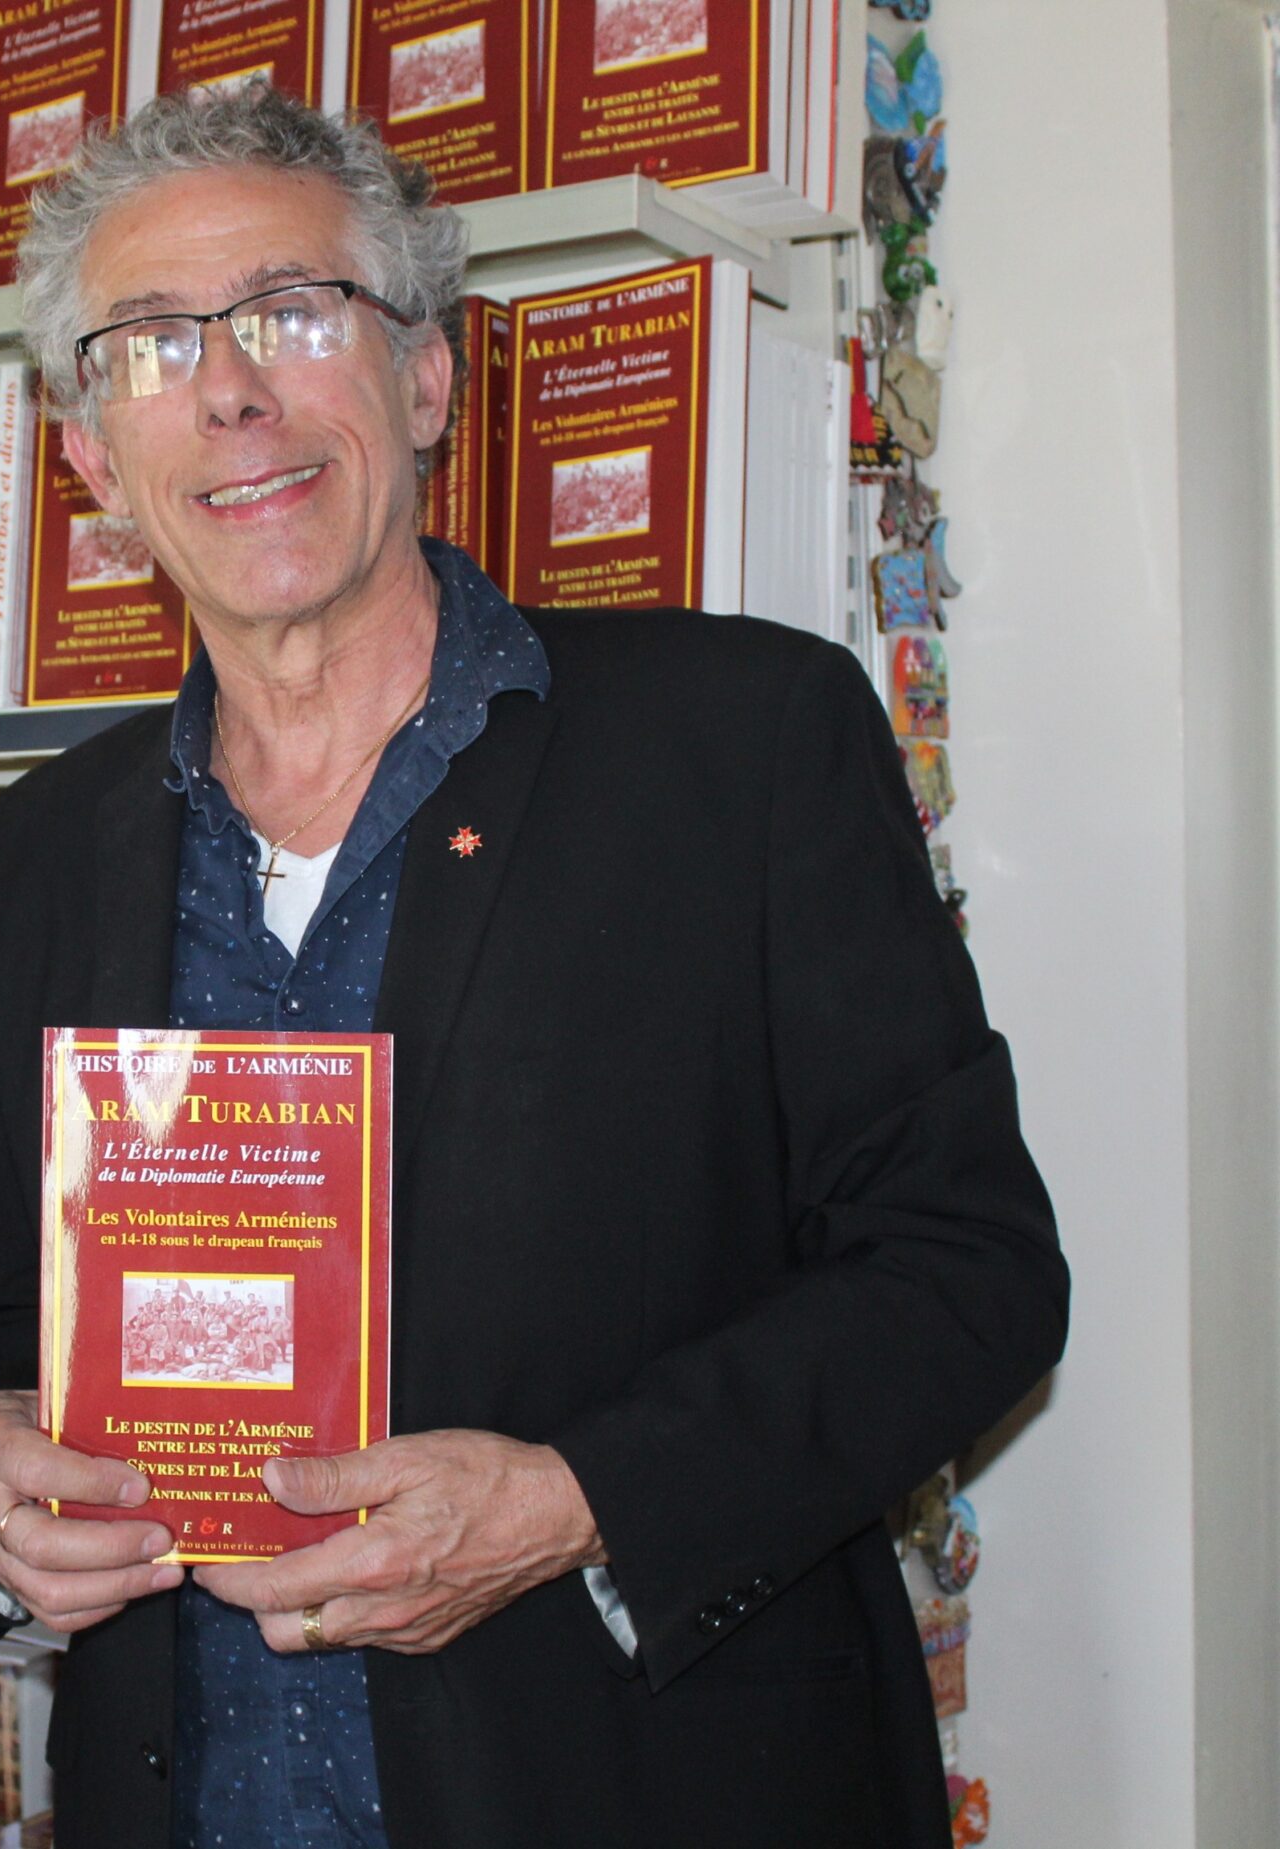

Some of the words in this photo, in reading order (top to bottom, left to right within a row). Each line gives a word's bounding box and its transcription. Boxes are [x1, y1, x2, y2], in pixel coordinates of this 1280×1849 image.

[529, 302, 593, 324] HISTOIRE
[597, 298, 611, 311] DE
[615, 276, 689, 307] L'ARMÉNIE
[524, 334, 584, 360] ARAM
[590, 312, 690, 348] TURABIAN
[0, 380, 18, 465] dictons
[0, 470, 12, 493] et
[77, 1055, 182, 1074] HISTOIRE
[193, 1059, 216, 1074] DE
[227, 1053, 352, 1076] L'ARMÉNIE
[72, 1092, 171, 1122] ARAM
[183, 1095, 356, 1124] TURABIAN
[103, 1141, 228, 1162] L'Éternelle
[240, 1144, 321, 1163] Victime
[98, 1168, 117, 1182] de
[121, 1168, 136, 1182] la
[140, 1168, 225, 1187] Diplomatie
[229, 1169, 325, 1188] Européenne
[87, 1209, 119, 1225] Les
[125, 1209, 229, 1228] Volontaires
[236, 1211, 337, 1229] Arméniens
[101, 1236, 116, 1246] en
[121, 1232, 157, 1246] 14-18
[160, 1236, 189, 1247] sous
[193, 1233, 205, 1247] le
[208, 1234, 264, 1250] drapeau
[268, 1235, 322, 1251] français
[105, 1417, 130, 1435] LE
[134, 1421, 191, 1435] DESTIN
[195, 1423, 215, 1436] DE
[219, 1419, 313, 1438] L'ARMÉNIE
[138, 1441, 185, 1453] ENTRE
[189, 1442, 215, 1454] LES
[219, 1442, 281, 1456] TRAITÉS
[187, 1464, 206, 1476] ET
[210, 1464, 229, 1477] DE
[150, 1487, 212, 1501] ANTRANIK
[215, 1492, 230, 1501] ET
[232, 1492, 254, 1502] LES
[183, 1521, 192, 1534] E
[200, 1516, 217, 1534] &
[222, 1522, 233, 1535] R
